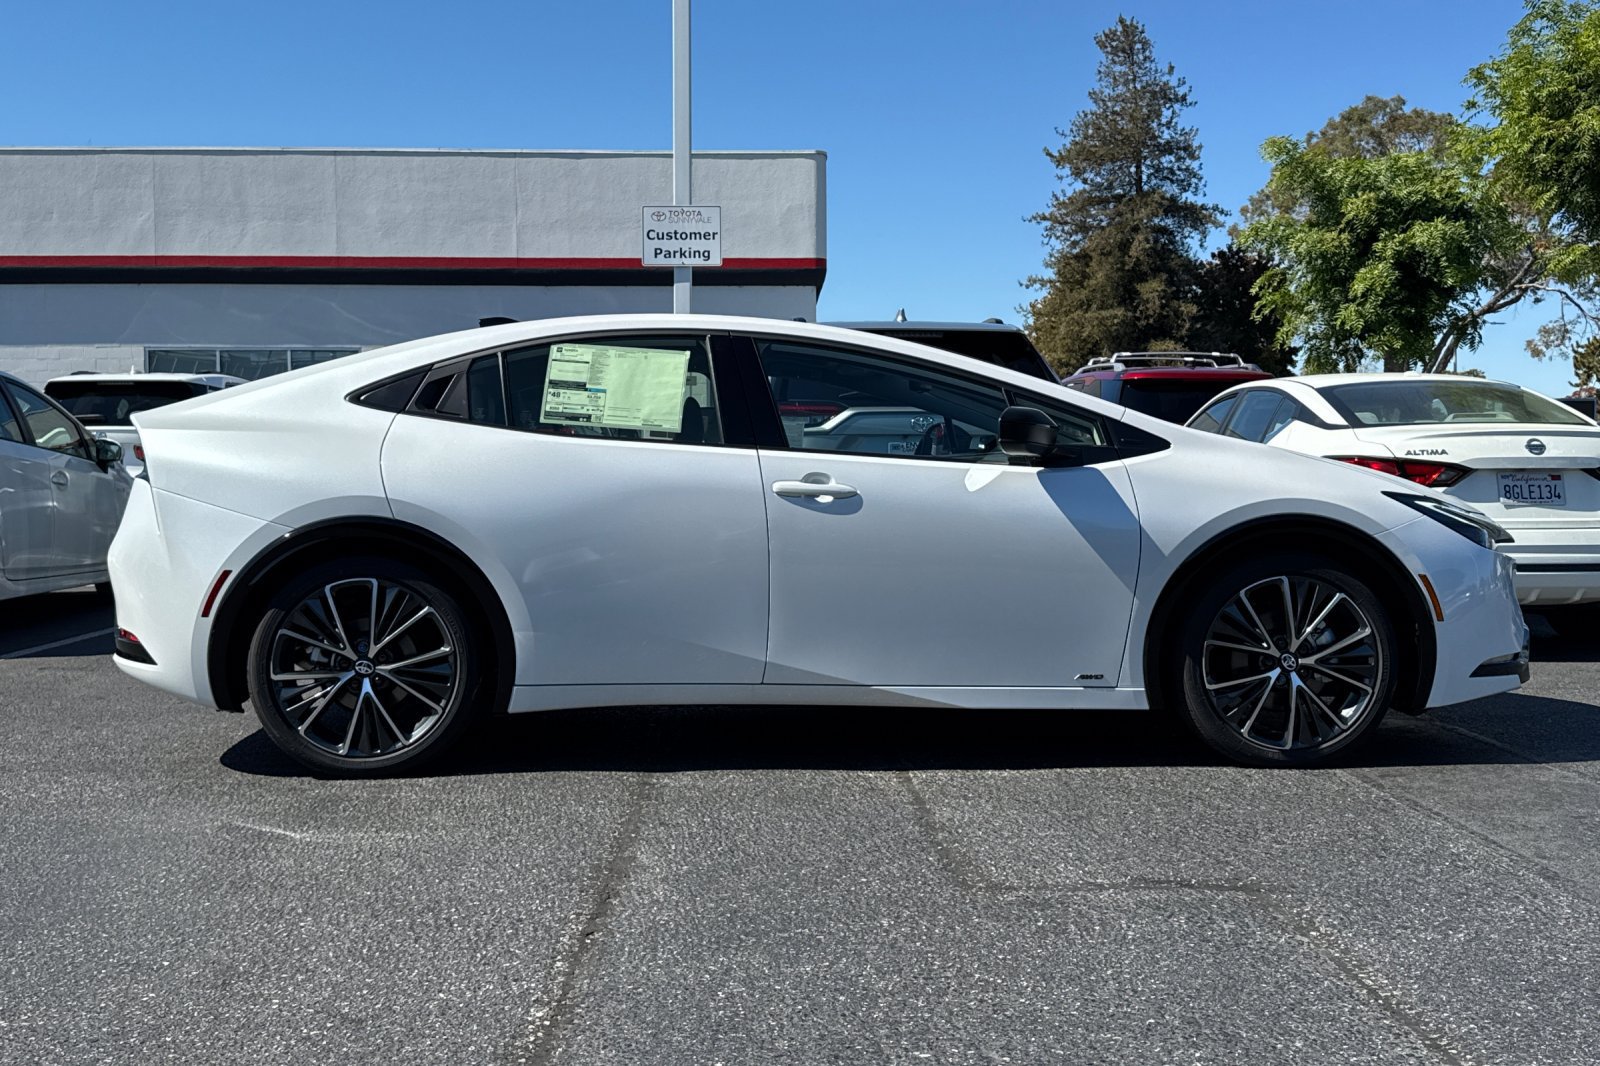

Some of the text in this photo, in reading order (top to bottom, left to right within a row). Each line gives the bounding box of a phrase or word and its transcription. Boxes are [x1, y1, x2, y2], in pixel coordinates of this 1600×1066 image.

[668, 209, 703, 217] TOYOTA
[668, 216, 713, 224] SUNNYVALE
[646, 229, 718, 241] Customer
[654, 247, 711, 262] Parking
[1511, 474, 1552, 484] California
[1503, 484, 1562, 500] 8GLE134
